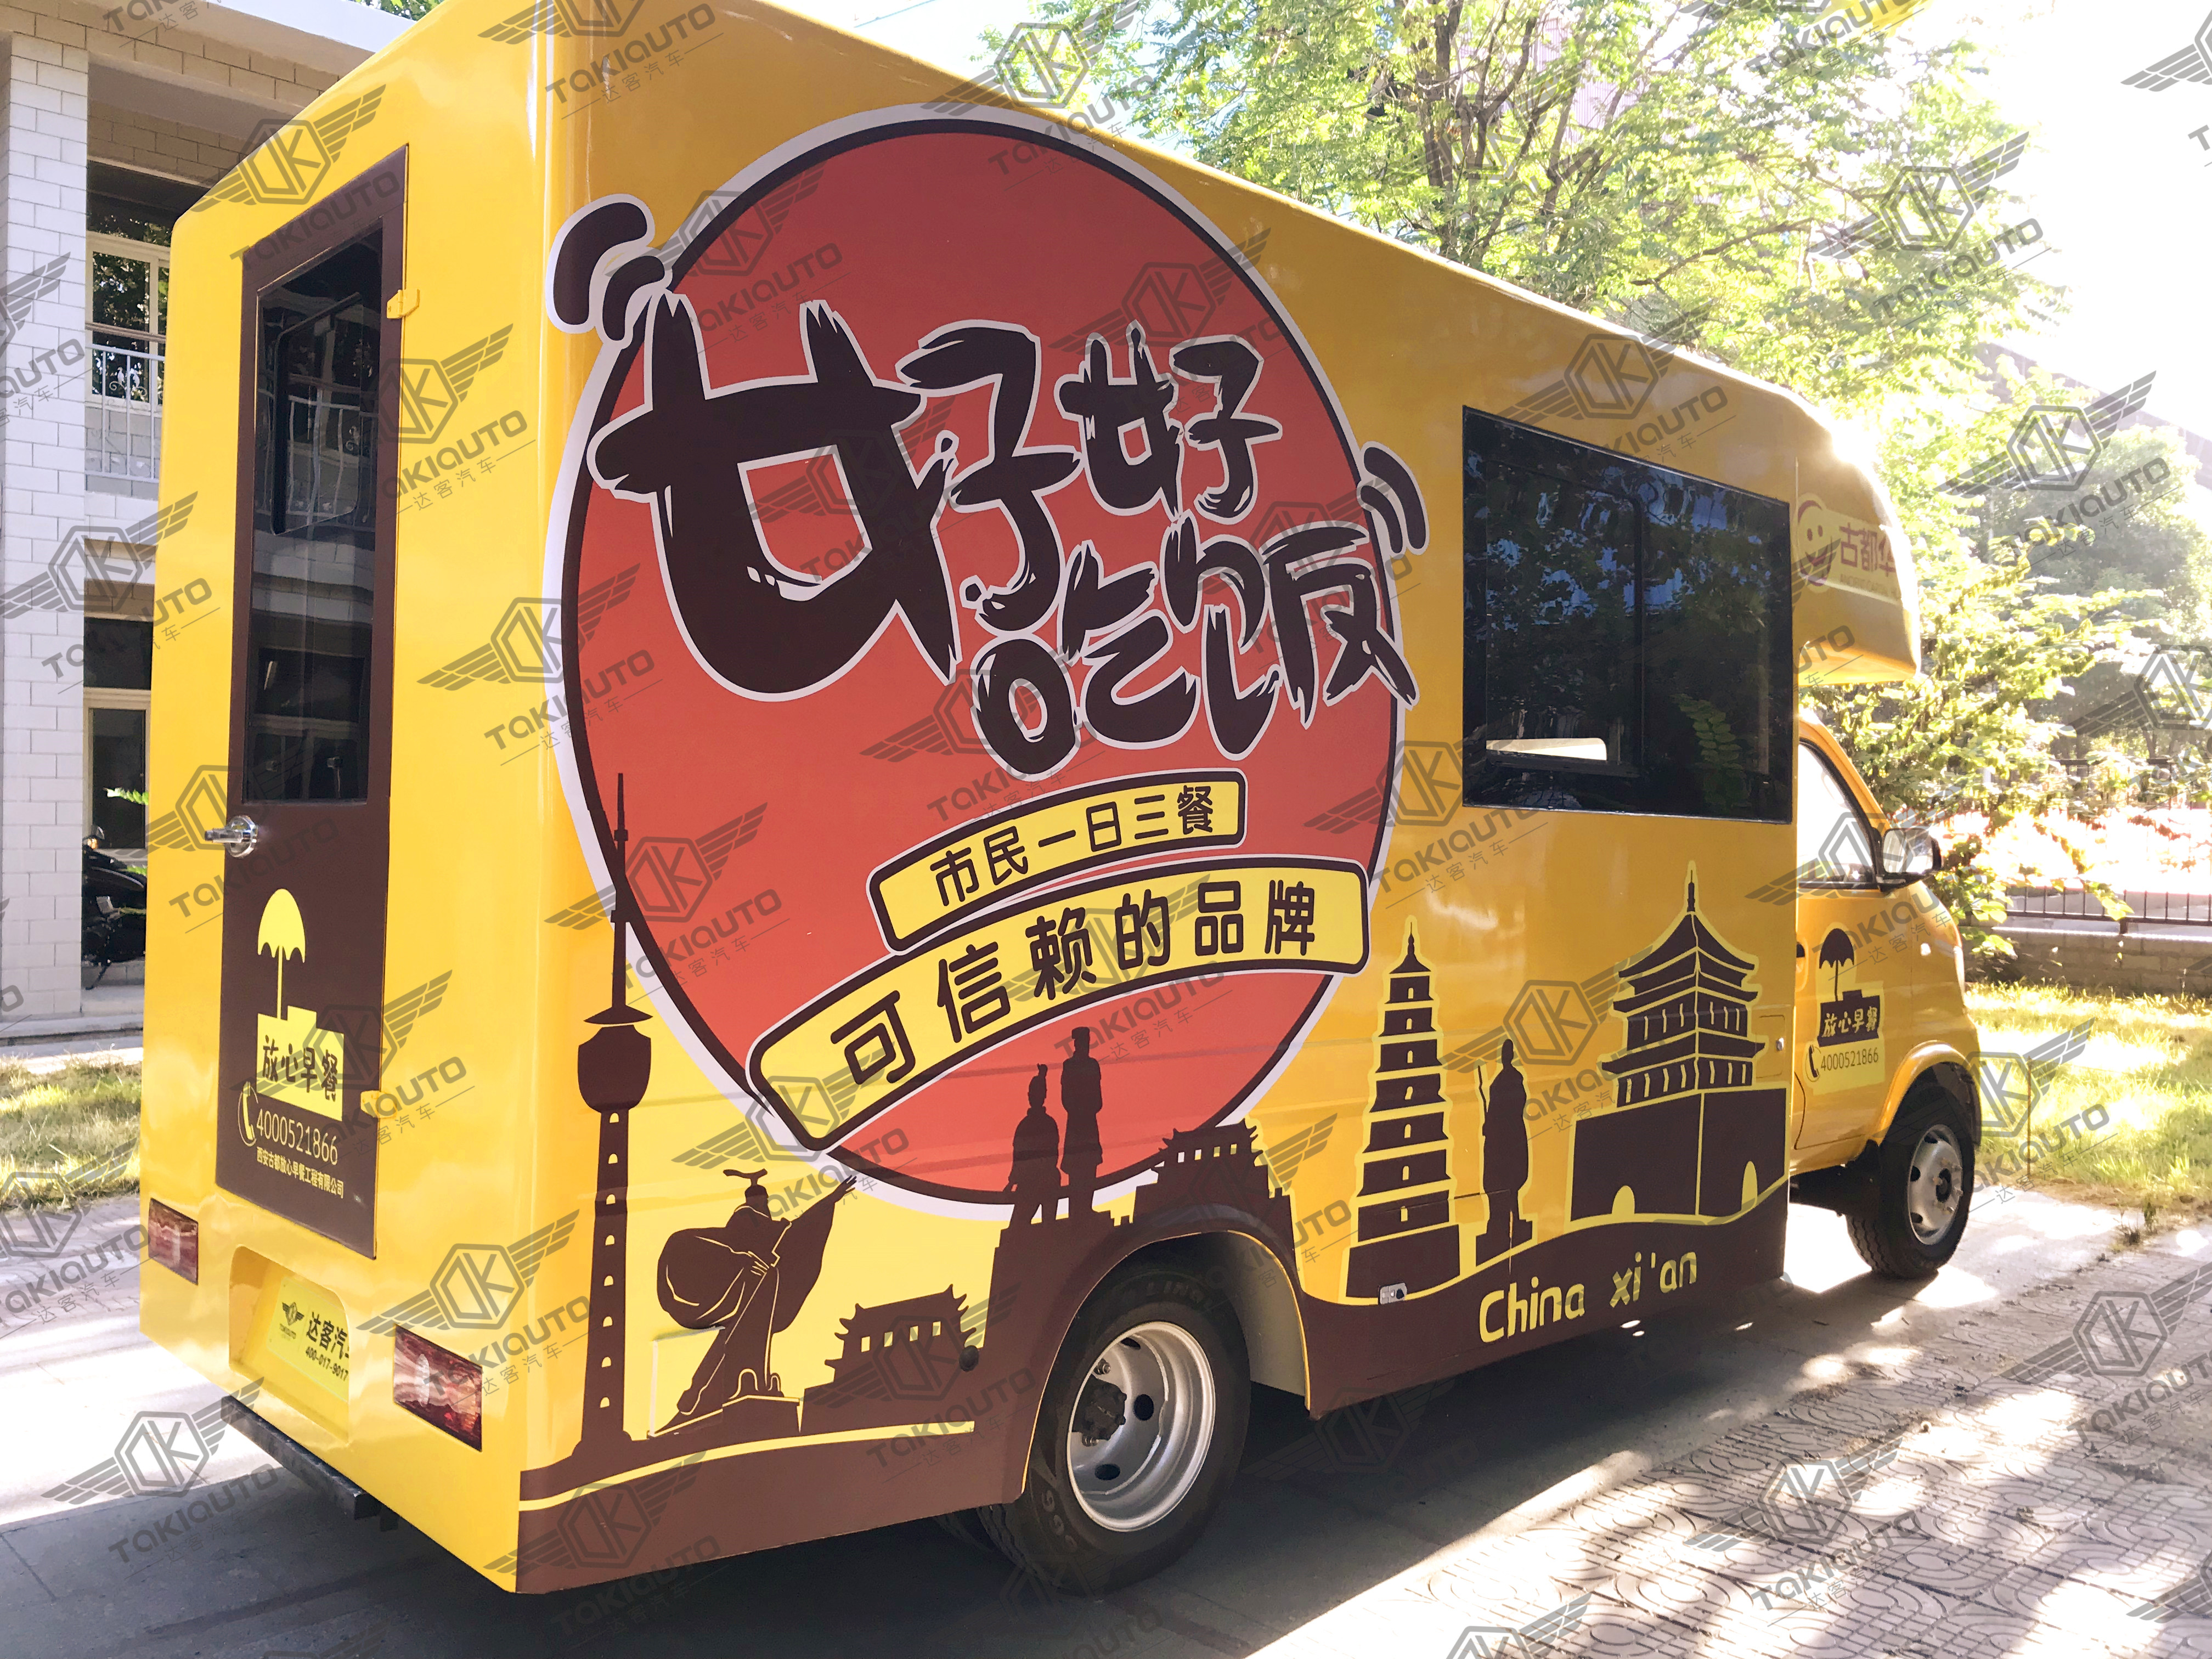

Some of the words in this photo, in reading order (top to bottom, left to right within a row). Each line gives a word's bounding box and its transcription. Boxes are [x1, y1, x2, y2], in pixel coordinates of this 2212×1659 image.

[929, 785, 1214, 907] 市民一日三餐
[829, 880, 1317, 1086] 可信赖的品牌
[1821, 1006, 1878, 1037] 放心早餐
[262, 1034, 338, 1102] 放心早餐
[1820, 1047, 1879, 1071] 4000521866
[256, 1108, 338, 1165] 4000521866
[306, 1311, 349, 1359] 达客汽
[1479, 1276, 1585, 1344] China
